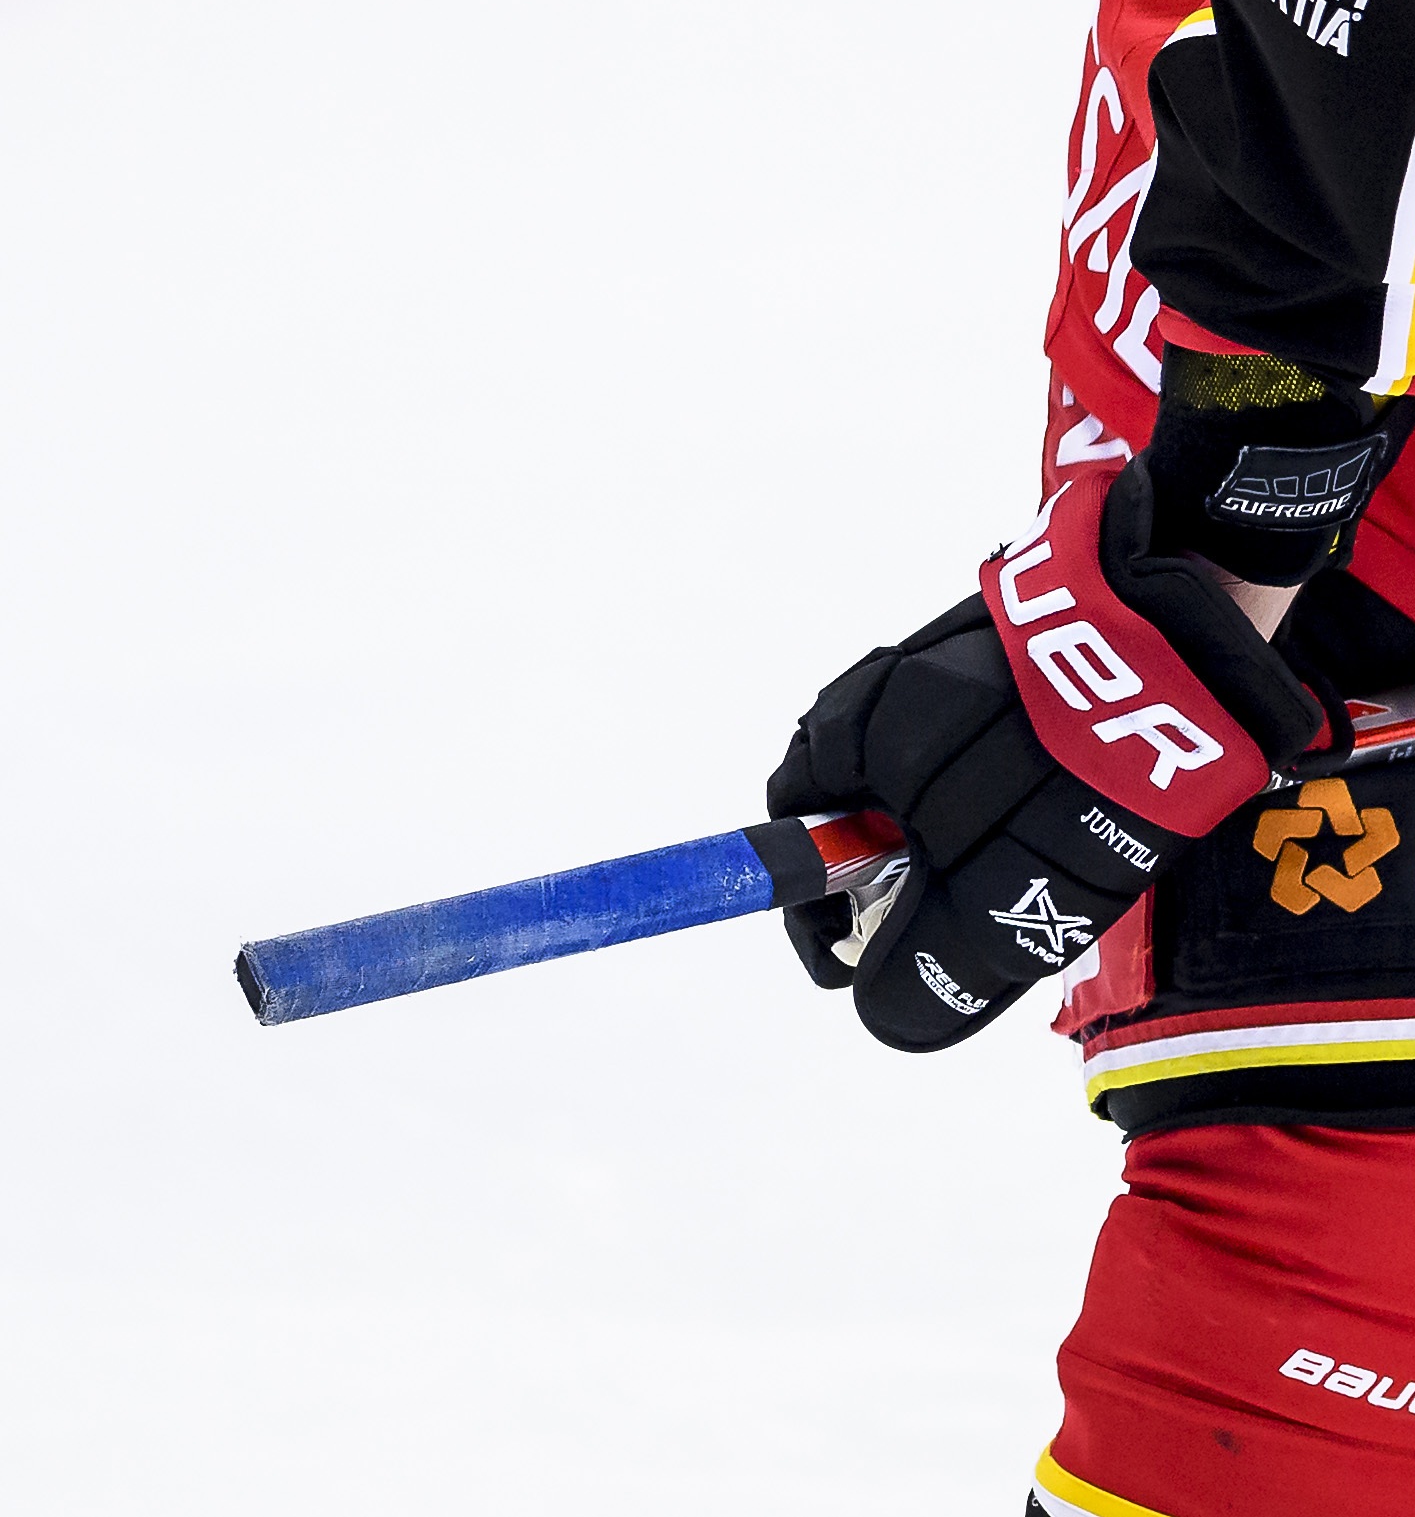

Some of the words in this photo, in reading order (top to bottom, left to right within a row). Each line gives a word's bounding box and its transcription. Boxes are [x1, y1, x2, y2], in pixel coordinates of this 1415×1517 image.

[1220, 492, 1353, 519] SUPREME
[1080, 806, 1159, 873] JUNTTILA
[916, 951, 961, 995] FREE
